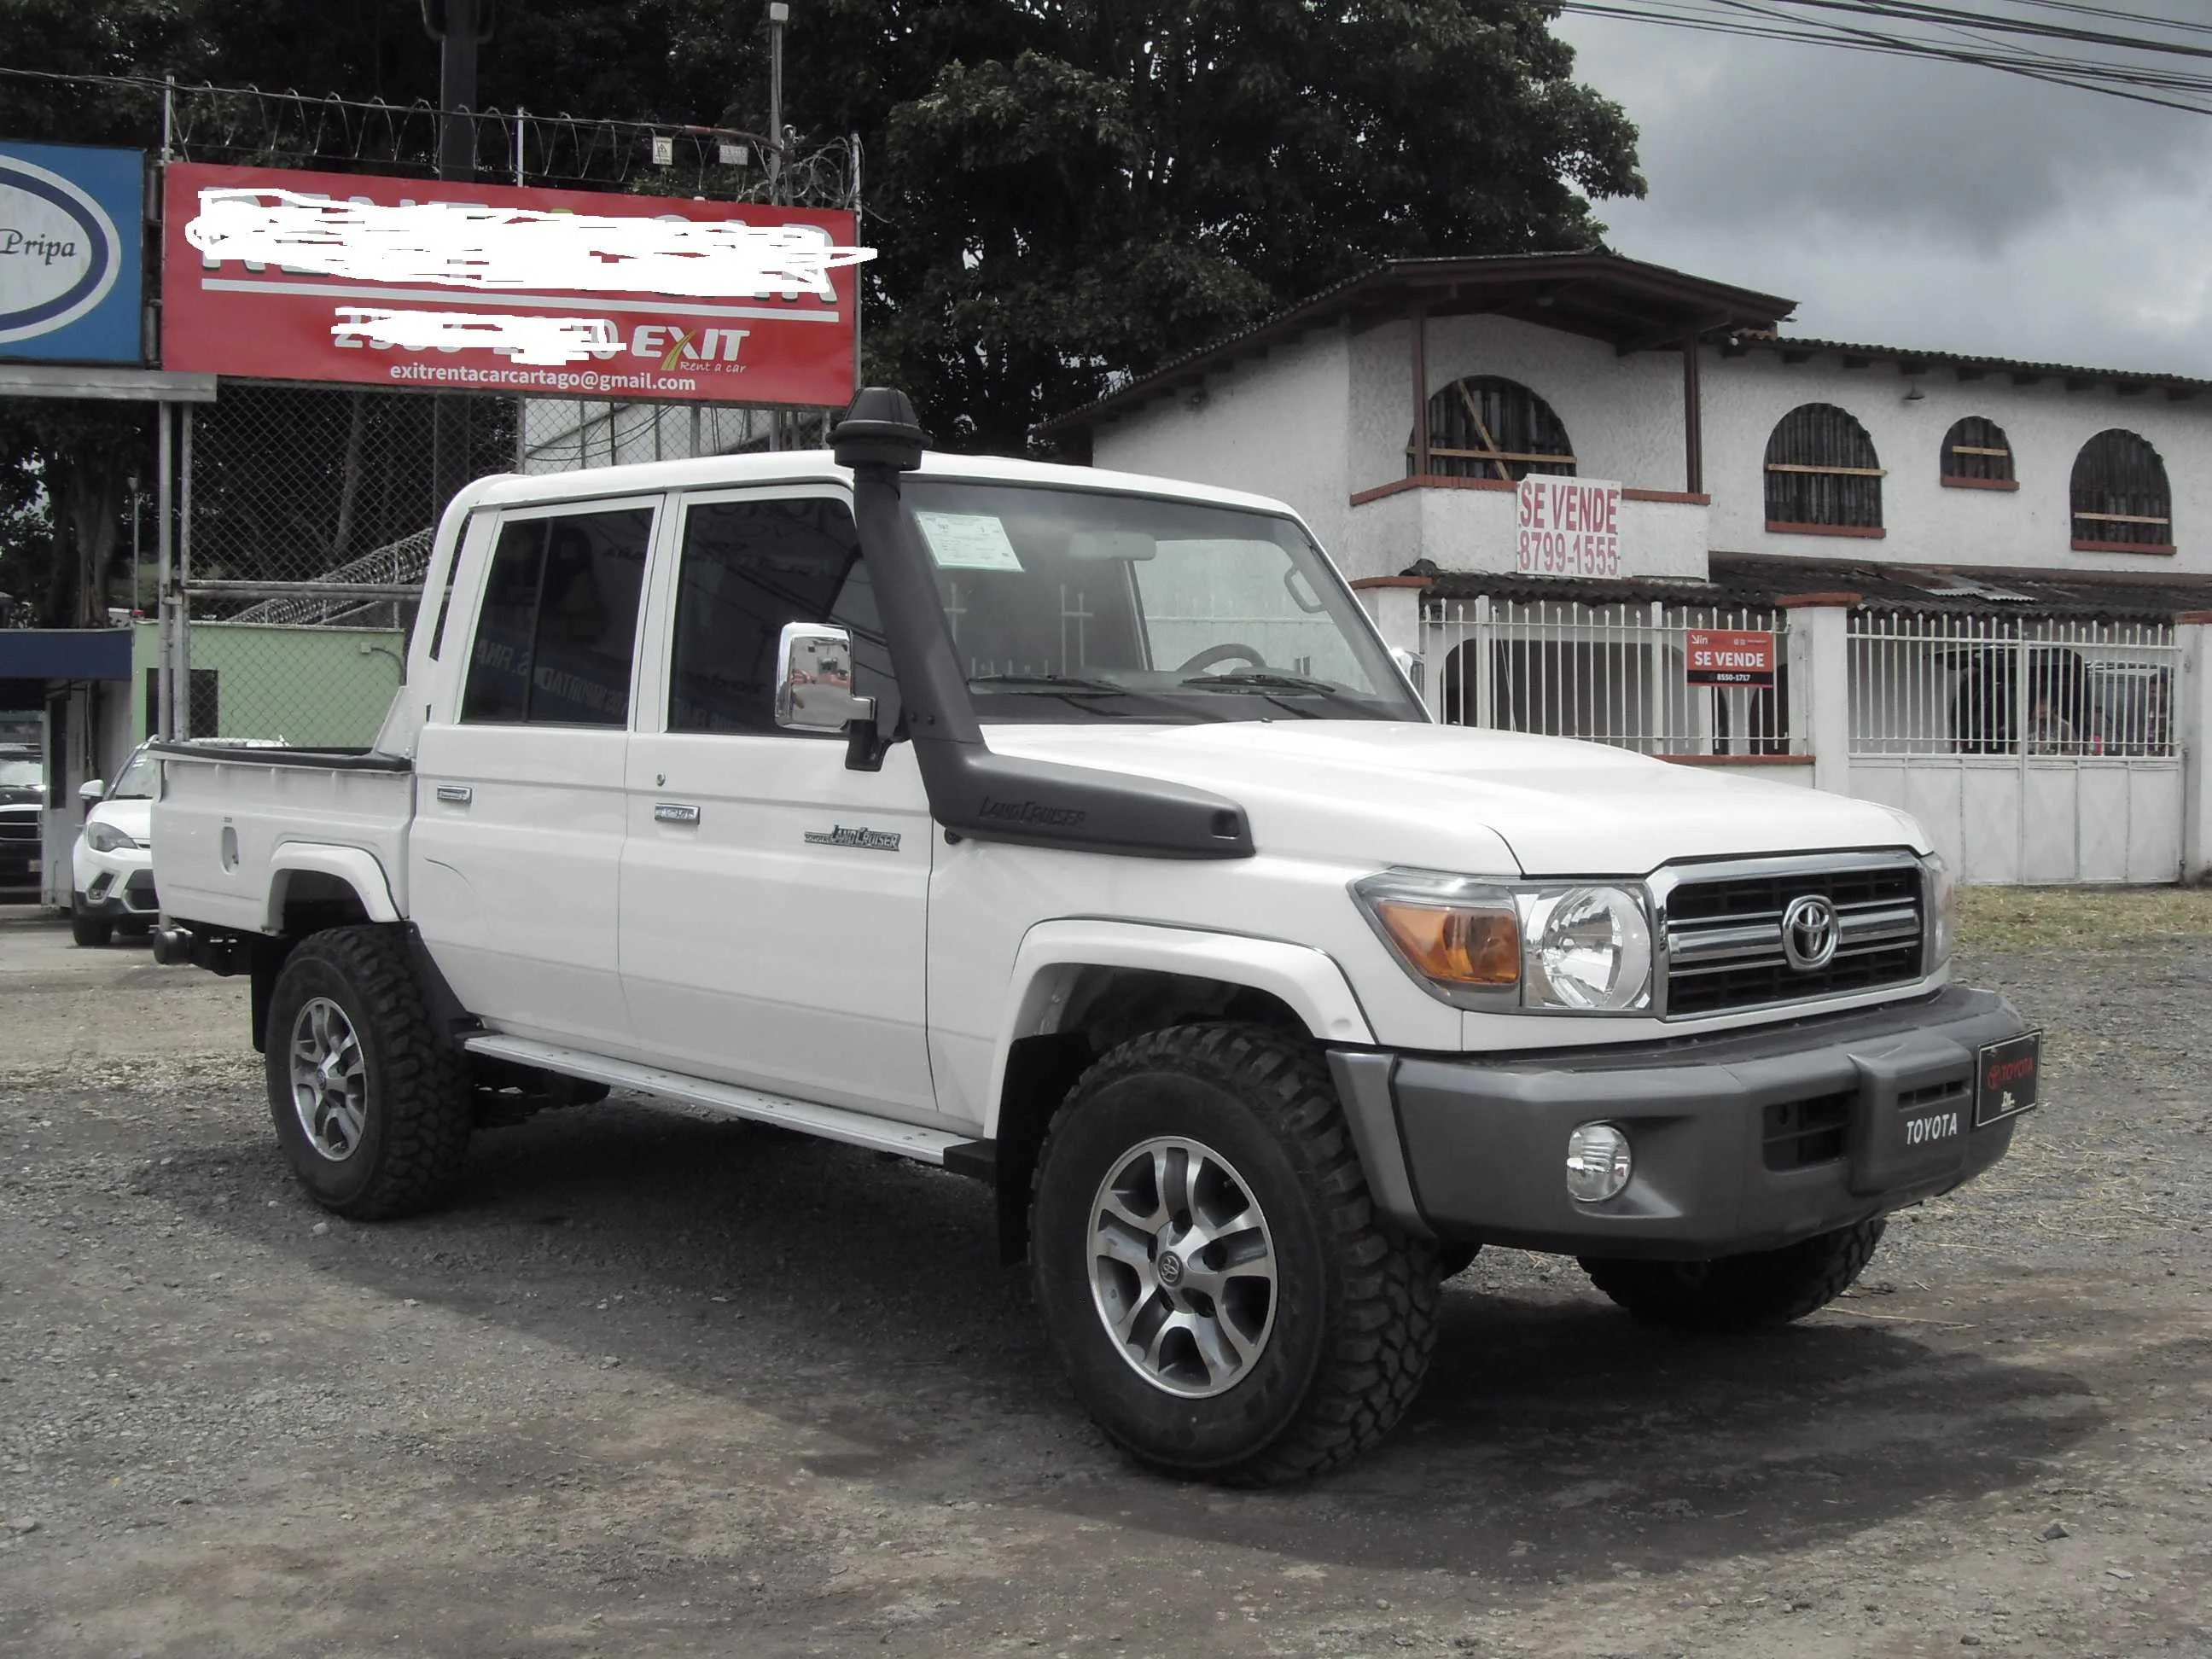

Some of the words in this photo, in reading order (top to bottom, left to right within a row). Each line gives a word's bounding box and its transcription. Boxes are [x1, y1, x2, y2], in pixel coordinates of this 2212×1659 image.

[632, 325, 750, 364] EXIT
[390, 362, 696, 392] exitrentacarcartago@gmail.com
[680, 359, 713, 373] Rent
[715, 363, 724, 372] a
[725, 363, 747, 374] car
[1520, 480, 1545, 529] SE
[1551, 484, 1618, 534] VENDE
[1519, 532, 1618, 576] 8799-1555
[1694, 650, 1712, 667] SE
[1714, 651, 1765, 667] VENDE
[857, 826, 901, 851] CRUISER
[1906, 1111, 1958, 1145] TOYOTA
